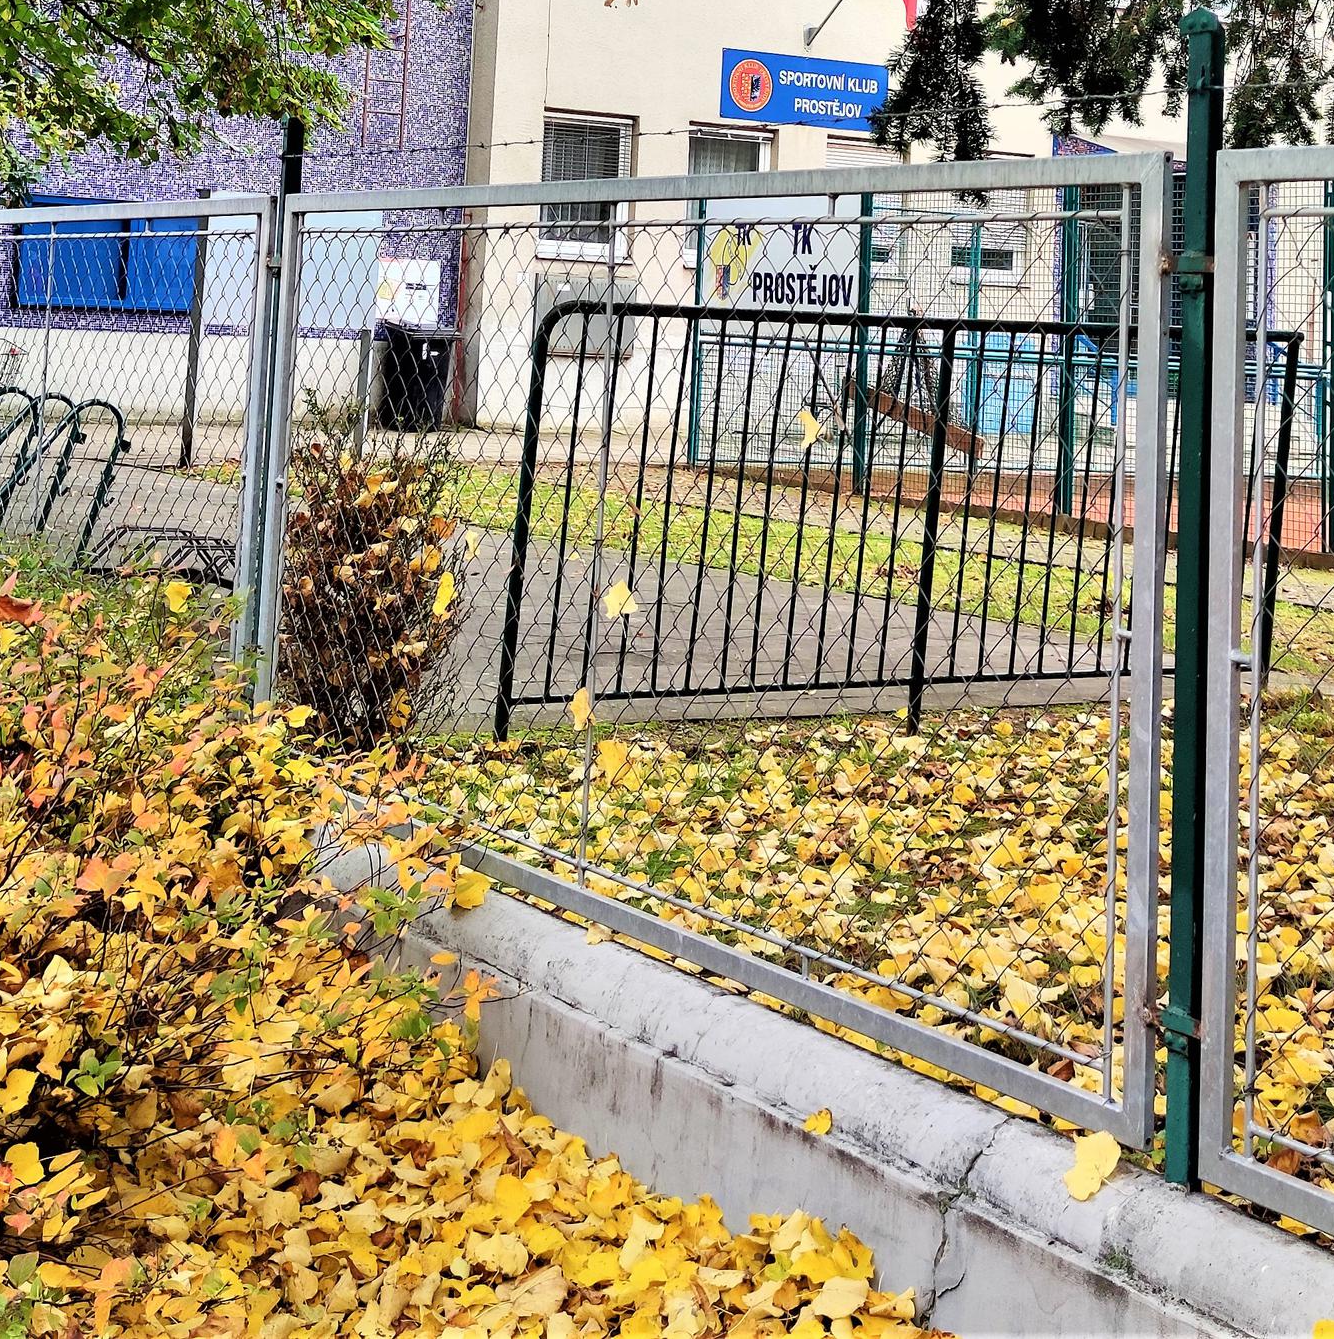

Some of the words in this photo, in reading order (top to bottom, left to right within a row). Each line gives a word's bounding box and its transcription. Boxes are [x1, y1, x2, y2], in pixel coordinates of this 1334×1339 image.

[779, 69, 846, 91] SPORTOVNÍ
[847, 77, 879, 94] KLUB
[795, 98, 862, 119] PROSTĚJOV
[792, 223, 812, 255] TK
[753, 264, 854, 307] PROSTĚJOV
